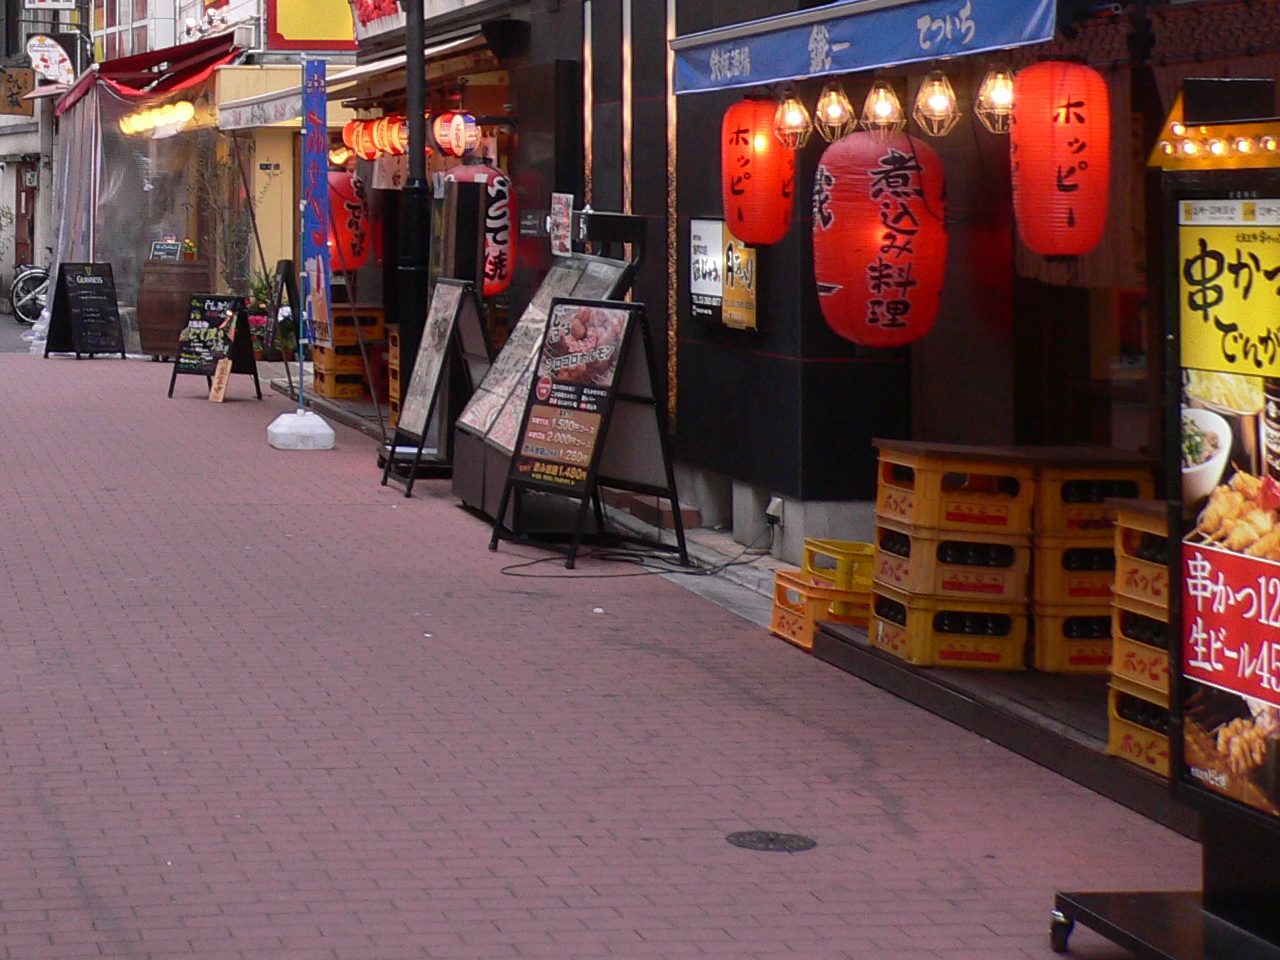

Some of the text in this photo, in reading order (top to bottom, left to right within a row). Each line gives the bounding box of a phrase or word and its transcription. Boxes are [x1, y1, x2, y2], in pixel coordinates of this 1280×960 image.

[729, 125, 753, 223] ホッピー
[1052, 97, 1089, 228] ホッピー
[76, 275, 103, 284] GUINNESS
[866, 148, 924, 330] 煮込み料理
